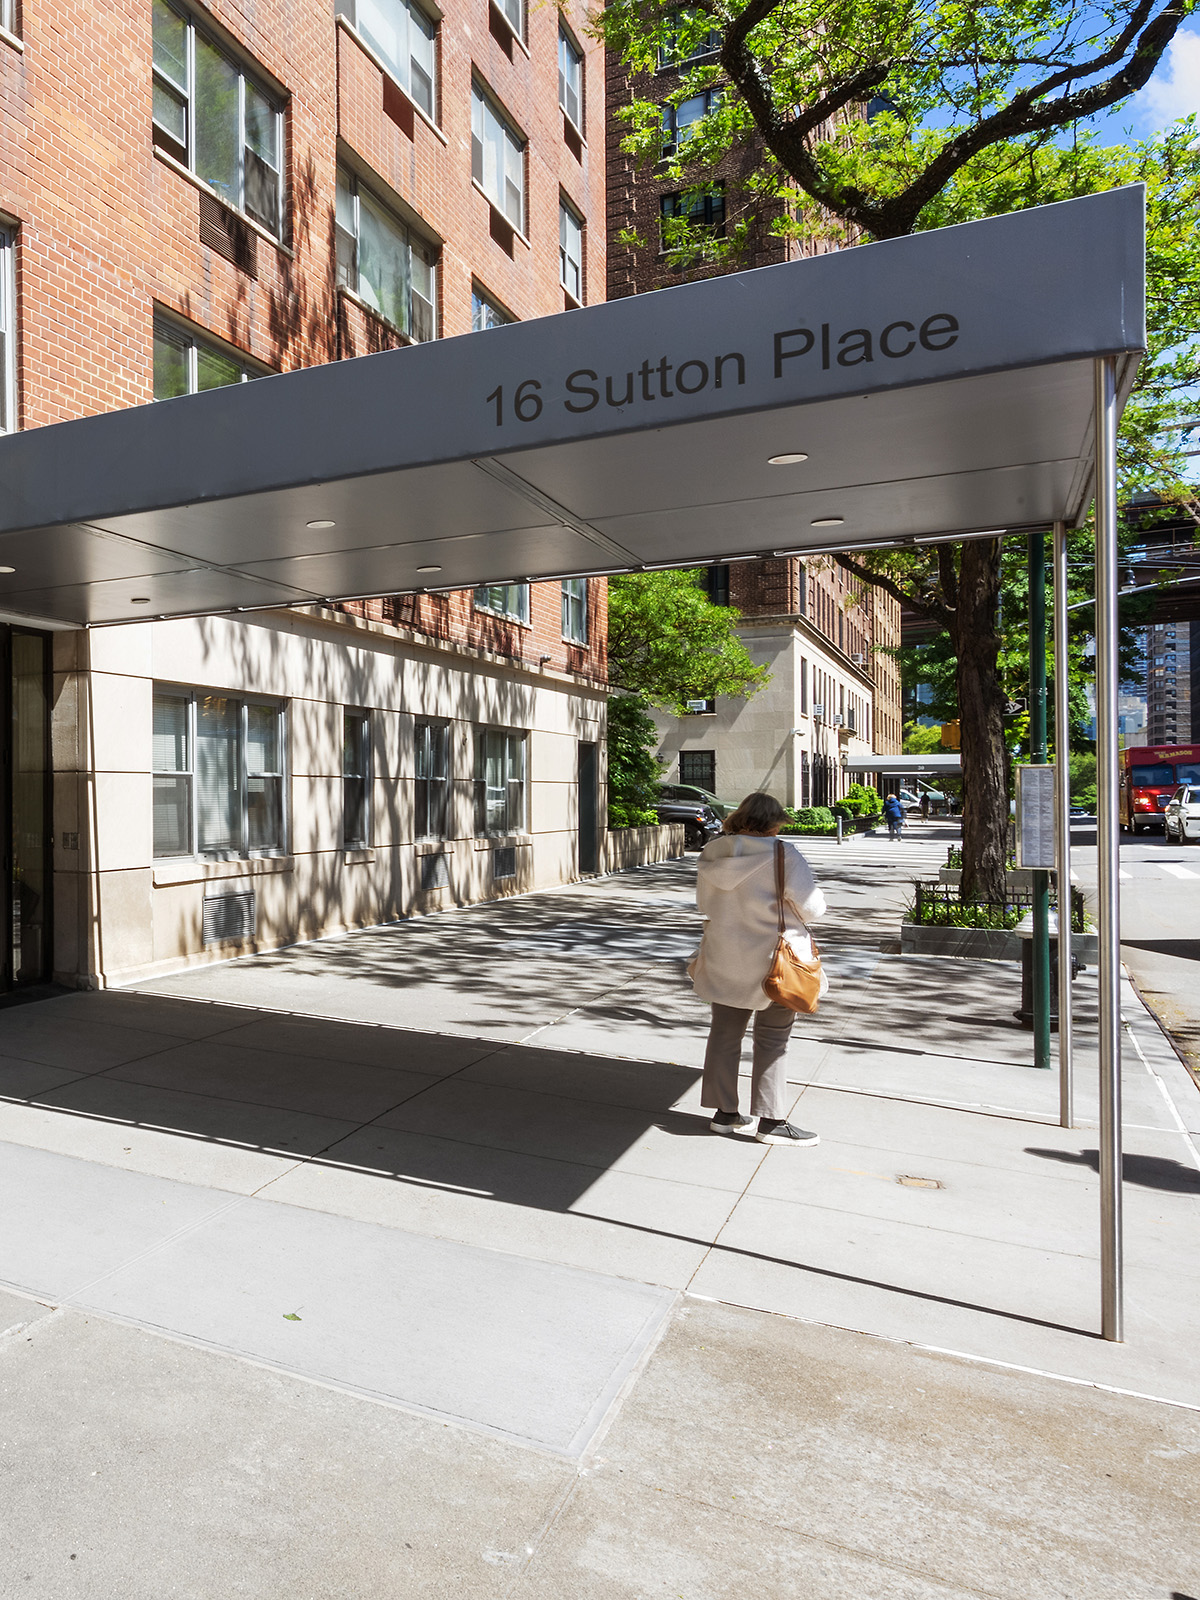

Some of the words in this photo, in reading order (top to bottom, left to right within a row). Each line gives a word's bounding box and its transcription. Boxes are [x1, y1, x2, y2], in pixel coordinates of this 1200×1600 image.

[486, 380, 543, 427] 16
[564, 350, 746, 414] Sutton
[772, 312, 960, 379] Place
